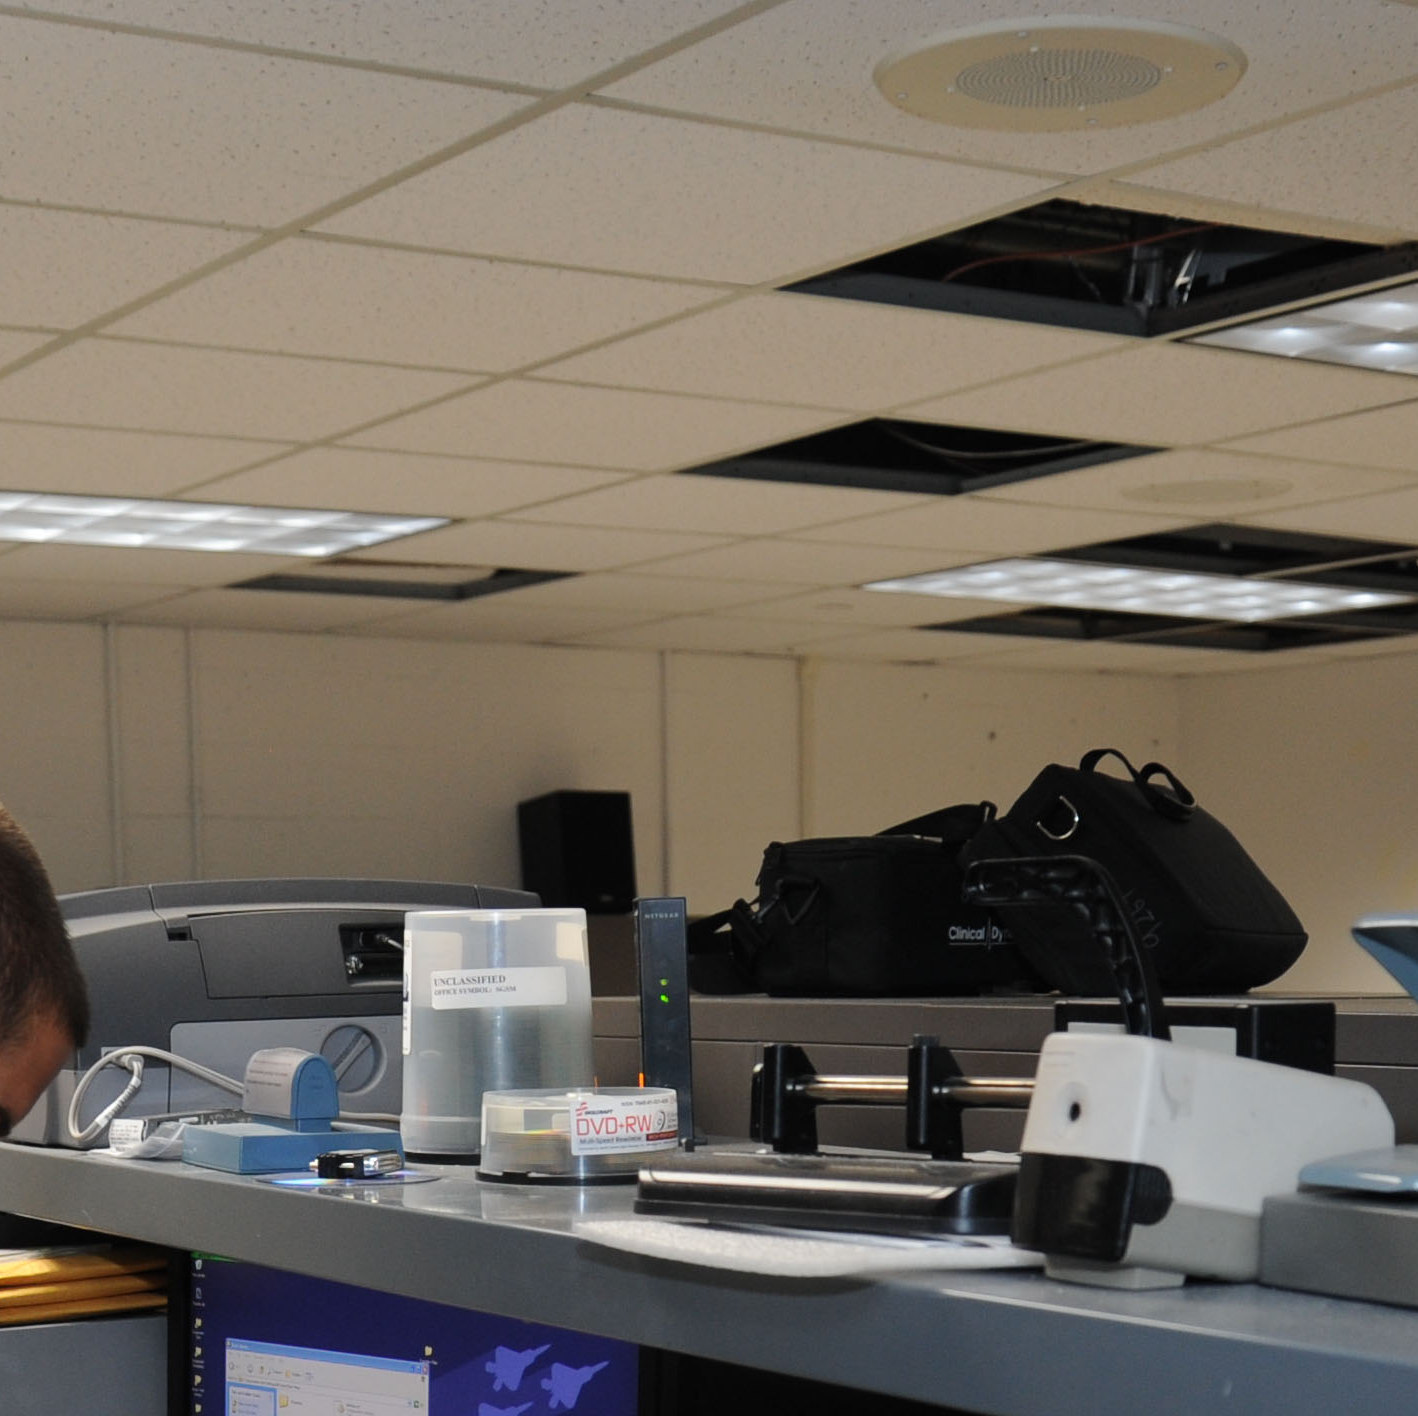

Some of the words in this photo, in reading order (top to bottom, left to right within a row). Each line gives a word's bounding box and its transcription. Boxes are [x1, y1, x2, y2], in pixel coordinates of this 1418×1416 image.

[949, 926, 985, 940] Clinical
[434, 974, 506, 987] UNCLASSIFIED
[434, 987, 457, 996] OFFICE
[576, 1115, 652, 1136] DVD+RW
